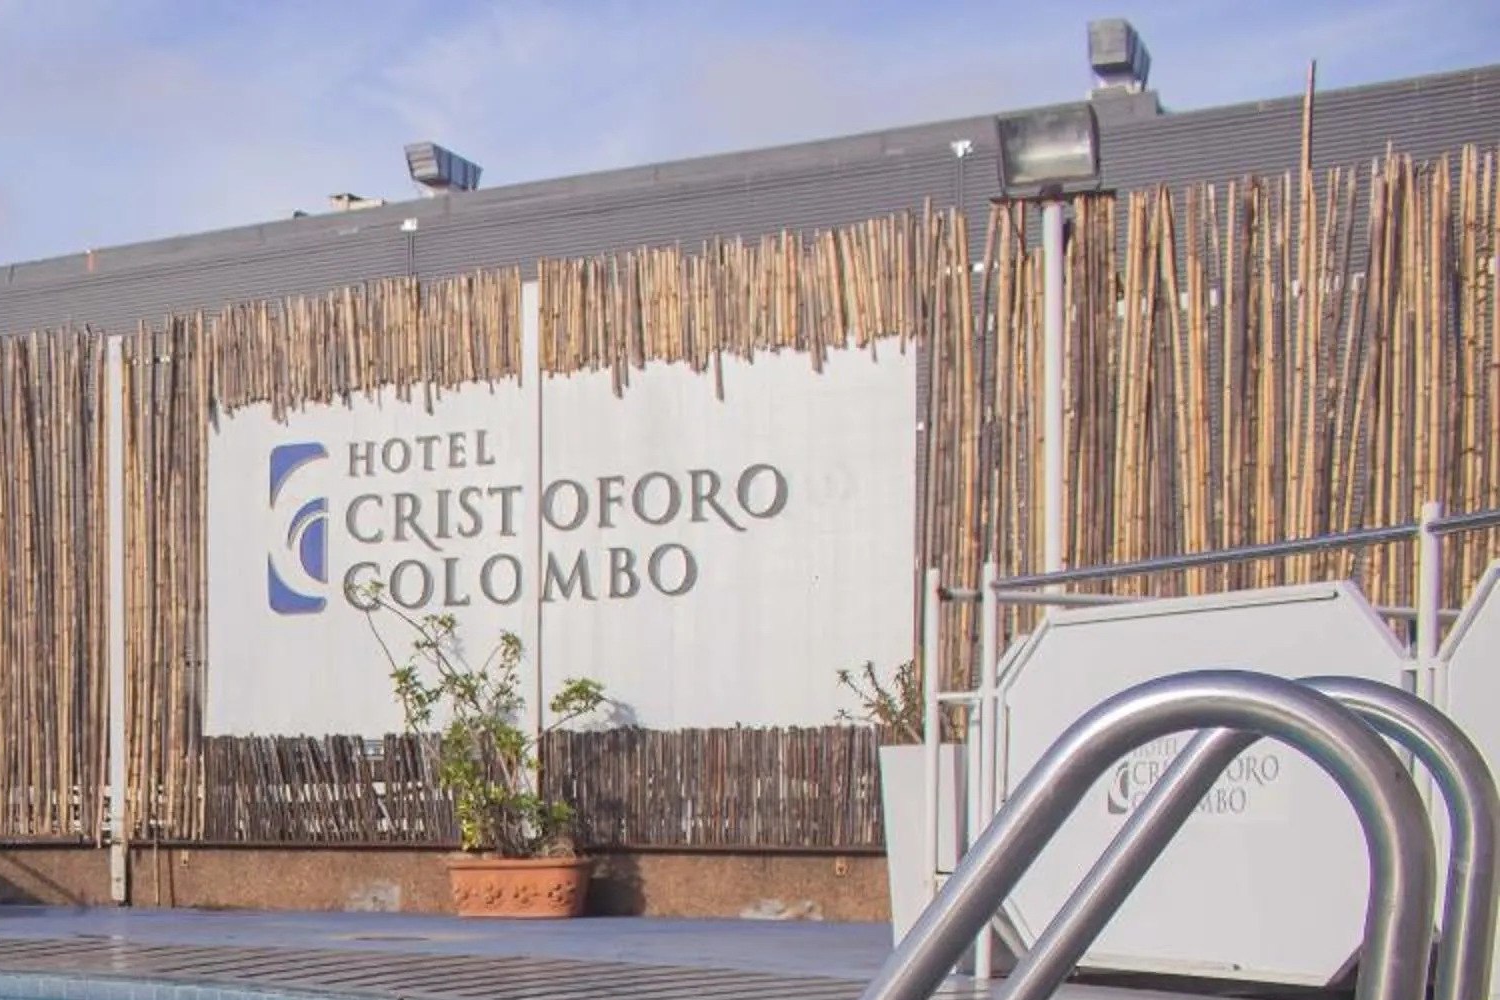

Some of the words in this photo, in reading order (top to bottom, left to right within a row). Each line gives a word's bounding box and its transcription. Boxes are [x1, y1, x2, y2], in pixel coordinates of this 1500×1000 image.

[347, 430, 495, 477] HOTEL
[345, 463, 788, 551] CRISTOFORO
[343, 543, 698, 611] COLOMBO
